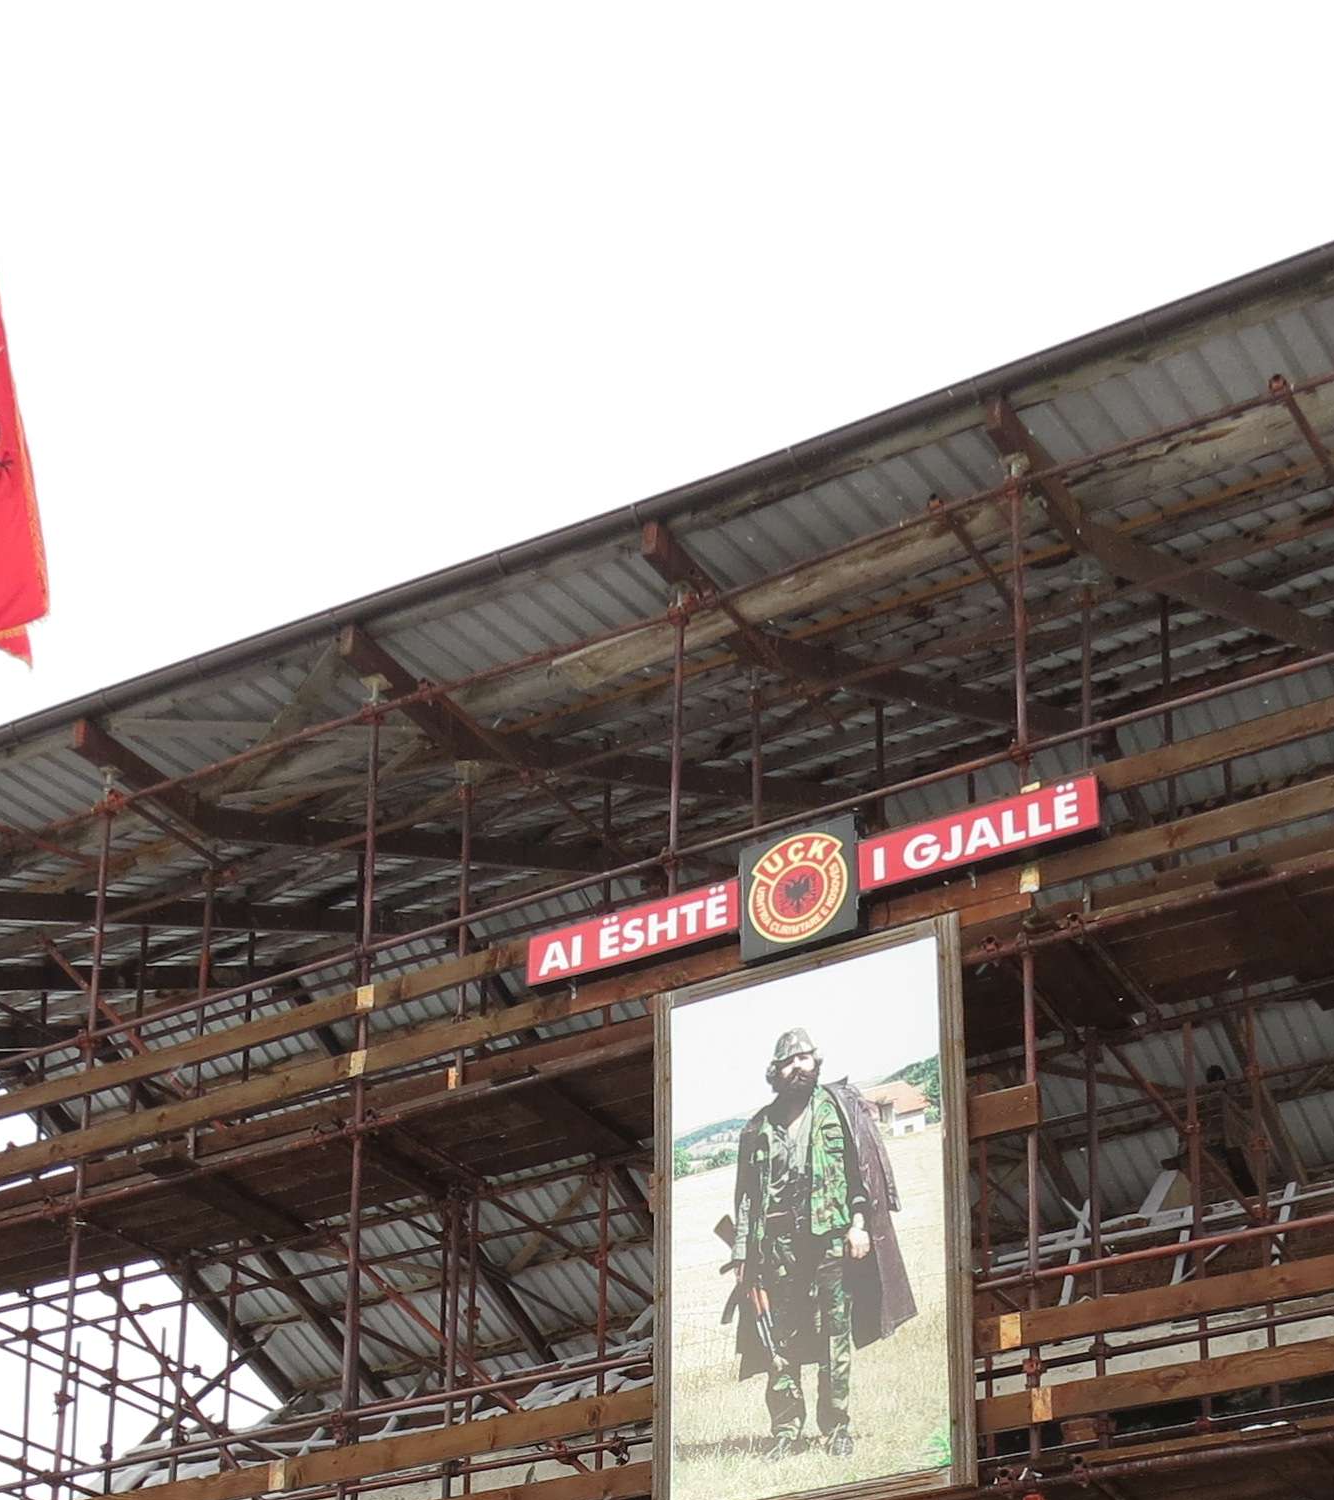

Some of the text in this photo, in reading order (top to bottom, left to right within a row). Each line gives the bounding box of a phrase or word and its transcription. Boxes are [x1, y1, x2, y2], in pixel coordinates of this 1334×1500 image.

[763, 839, 830, 873] UÇK
[873, 783, 1078, 881] I GJALLË
[539, 887, 729, 977] AI ËSHTË
